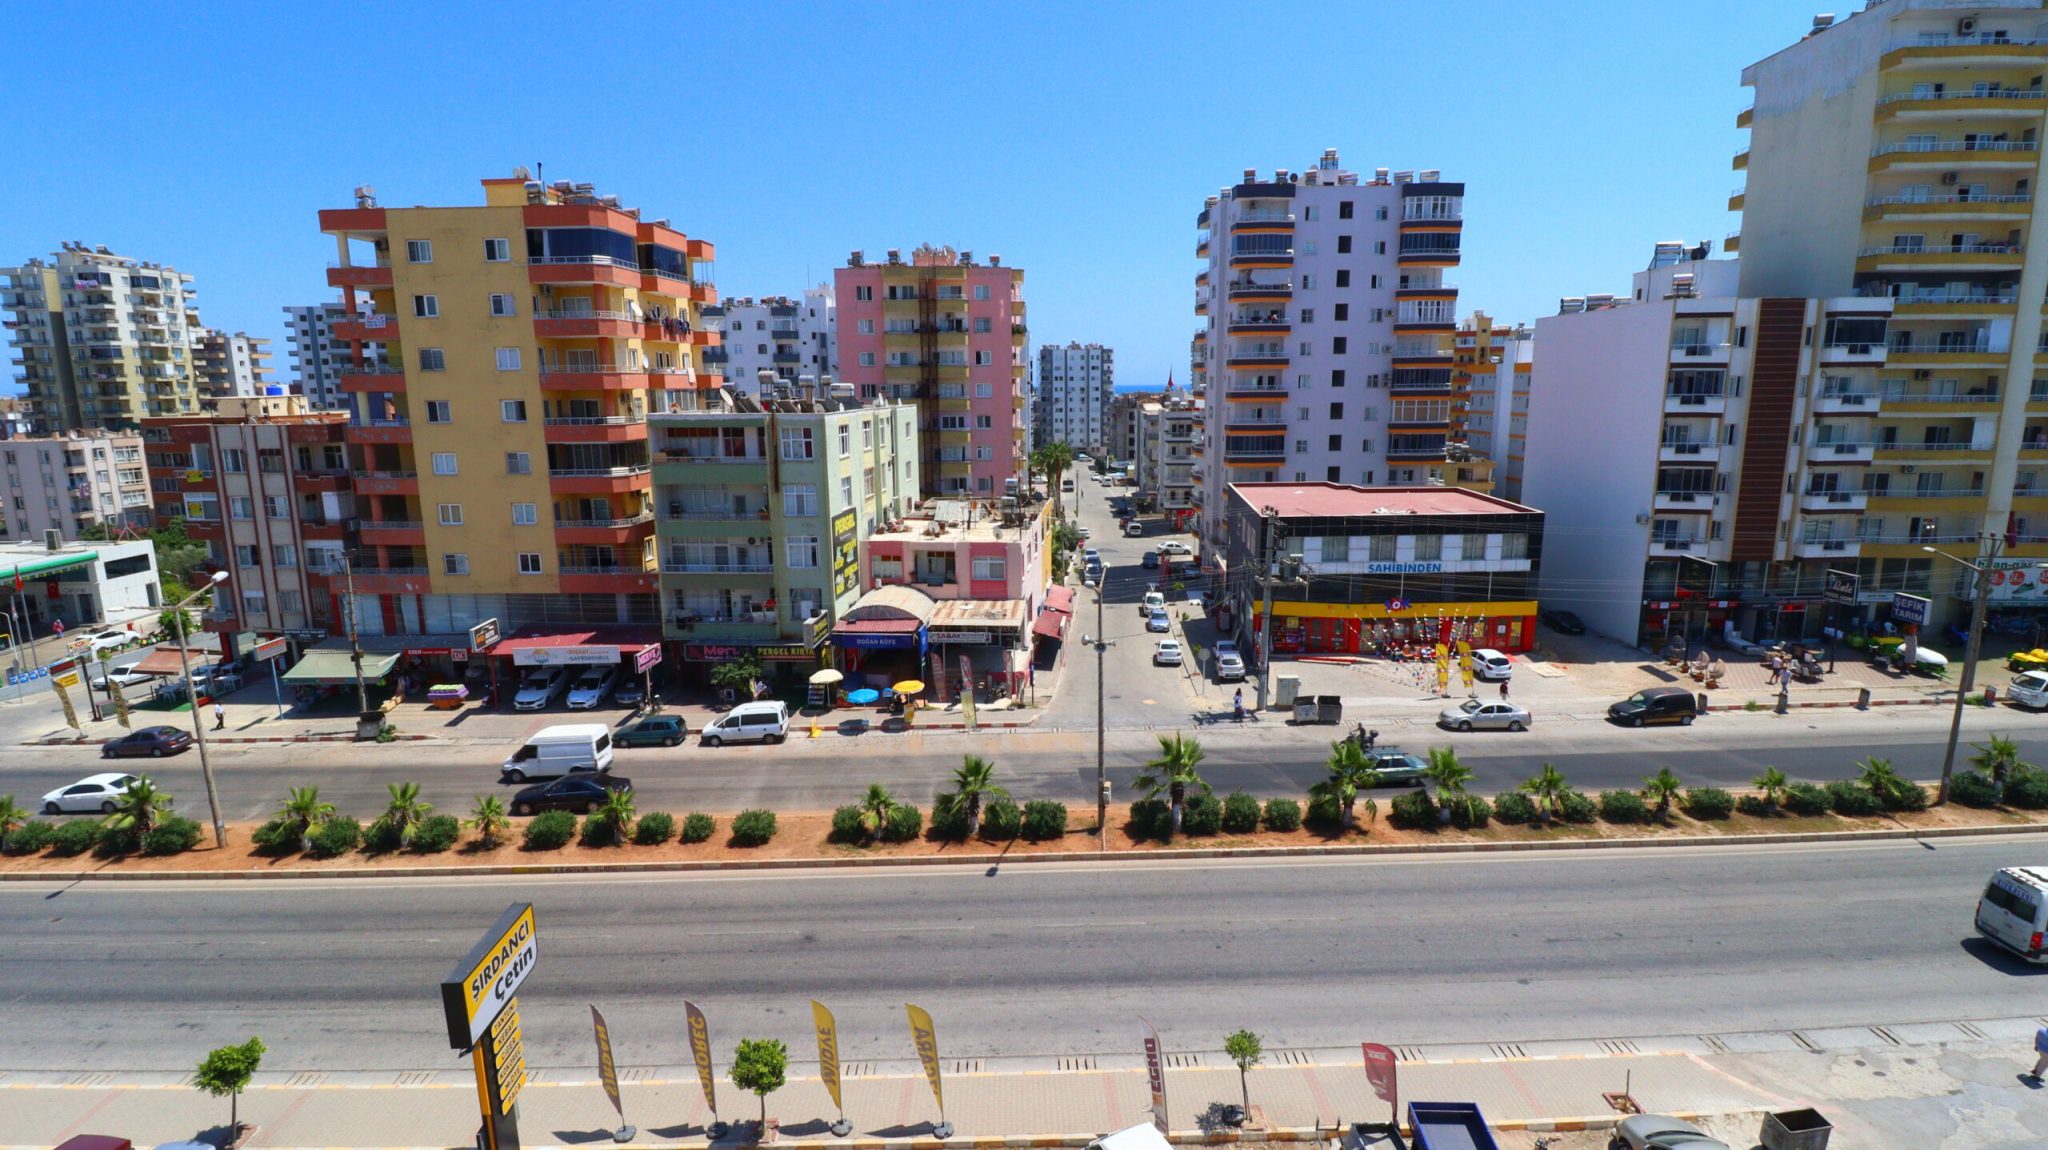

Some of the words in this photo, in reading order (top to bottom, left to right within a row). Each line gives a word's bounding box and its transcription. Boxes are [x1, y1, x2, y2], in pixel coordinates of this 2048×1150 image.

[834, 513, 855, 536] PERGEL
[1894, 595, 1924, 611] ŞEFİK
[1894, 607, 1923, 622] TARIM
[757, 647, 789, 656] PERGEL
[472, 921, 529, 1002] ŞIRDANCI
[495, 946, 532, 1002] Çetin
